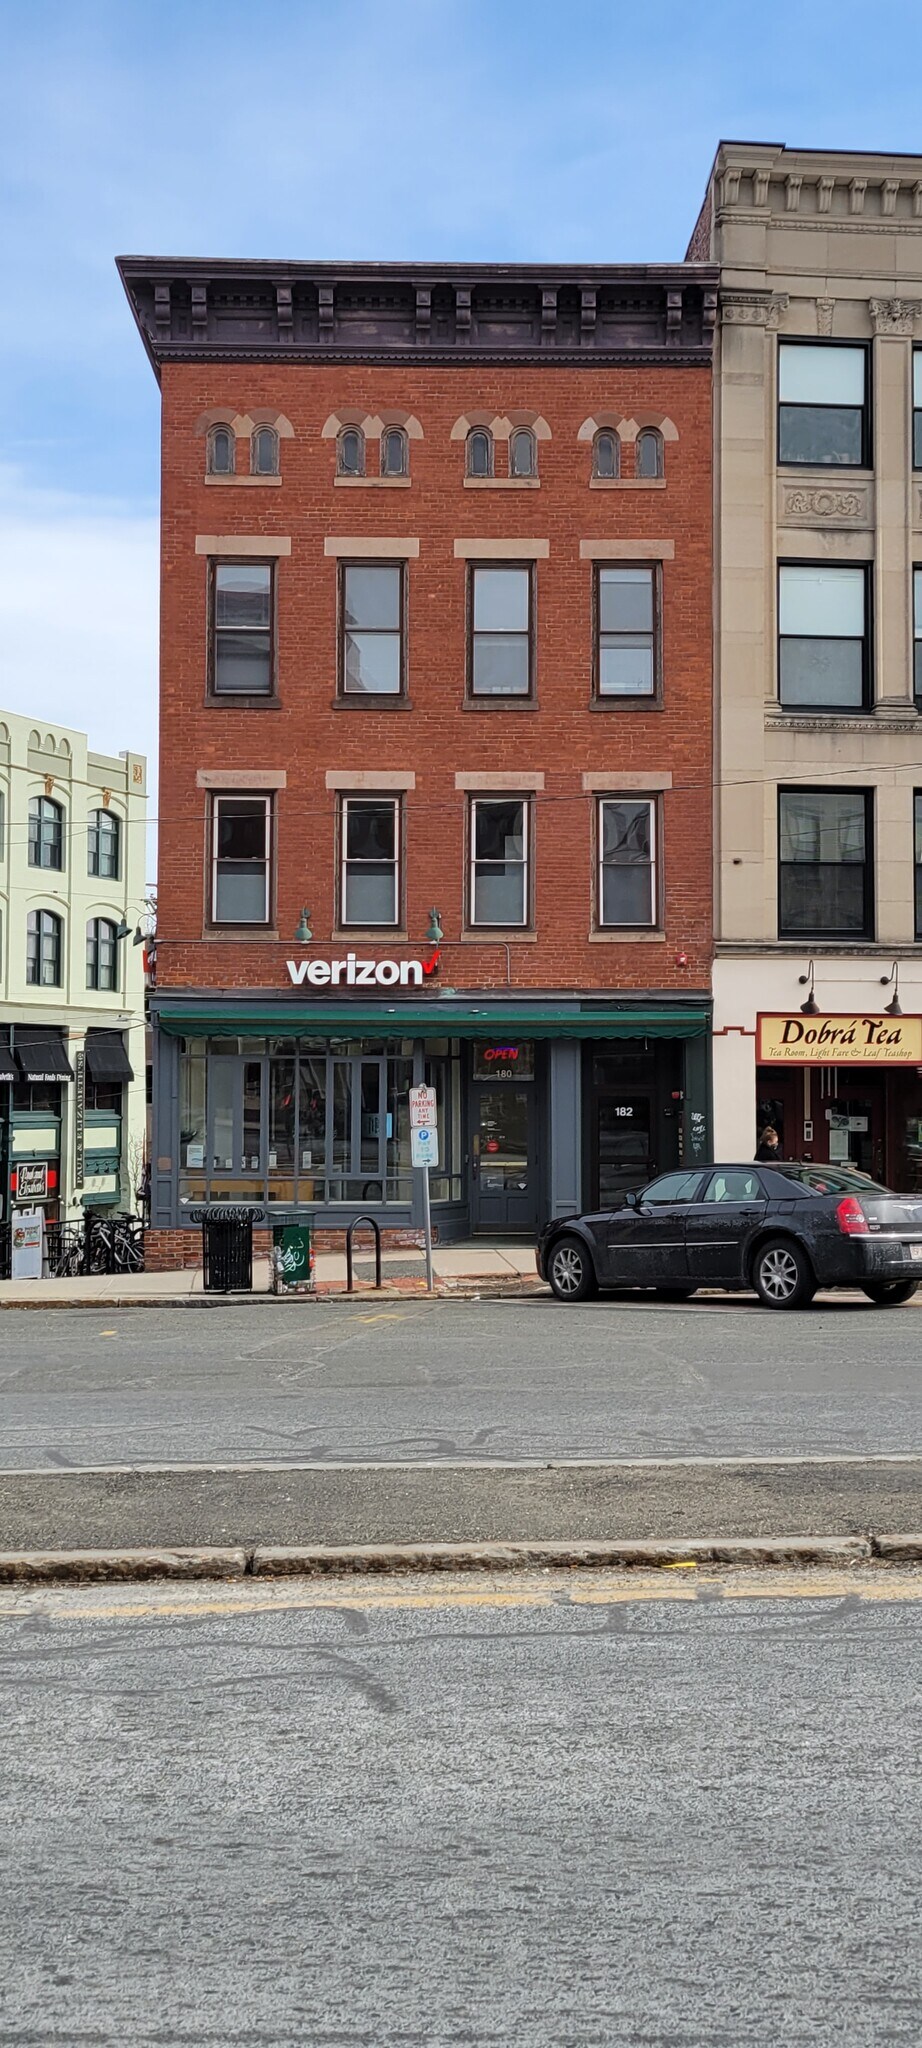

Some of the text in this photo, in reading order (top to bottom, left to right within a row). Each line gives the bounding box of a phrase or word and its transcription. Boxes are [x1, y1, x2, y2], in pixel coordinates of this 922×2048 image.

[286, 953, 423, 985] verizon
[779, 1019, 903, 1045] Dobrá Tea
[483, 1048, 519, 1060] OPEN
[769, 1047, 913, 1059] Tea Room, Light Fare & Leaf Teashop
[27, 1073, 71, 1081] Natural Foods Dining
[495, 1069, 512, 1078] 180
[417, 1091, 428, 1099] NO
[411, 1100, 434, 1108] PARKING
[615, 1107, 633, 1117] 182
[77, 1142, 83, 1152] &
